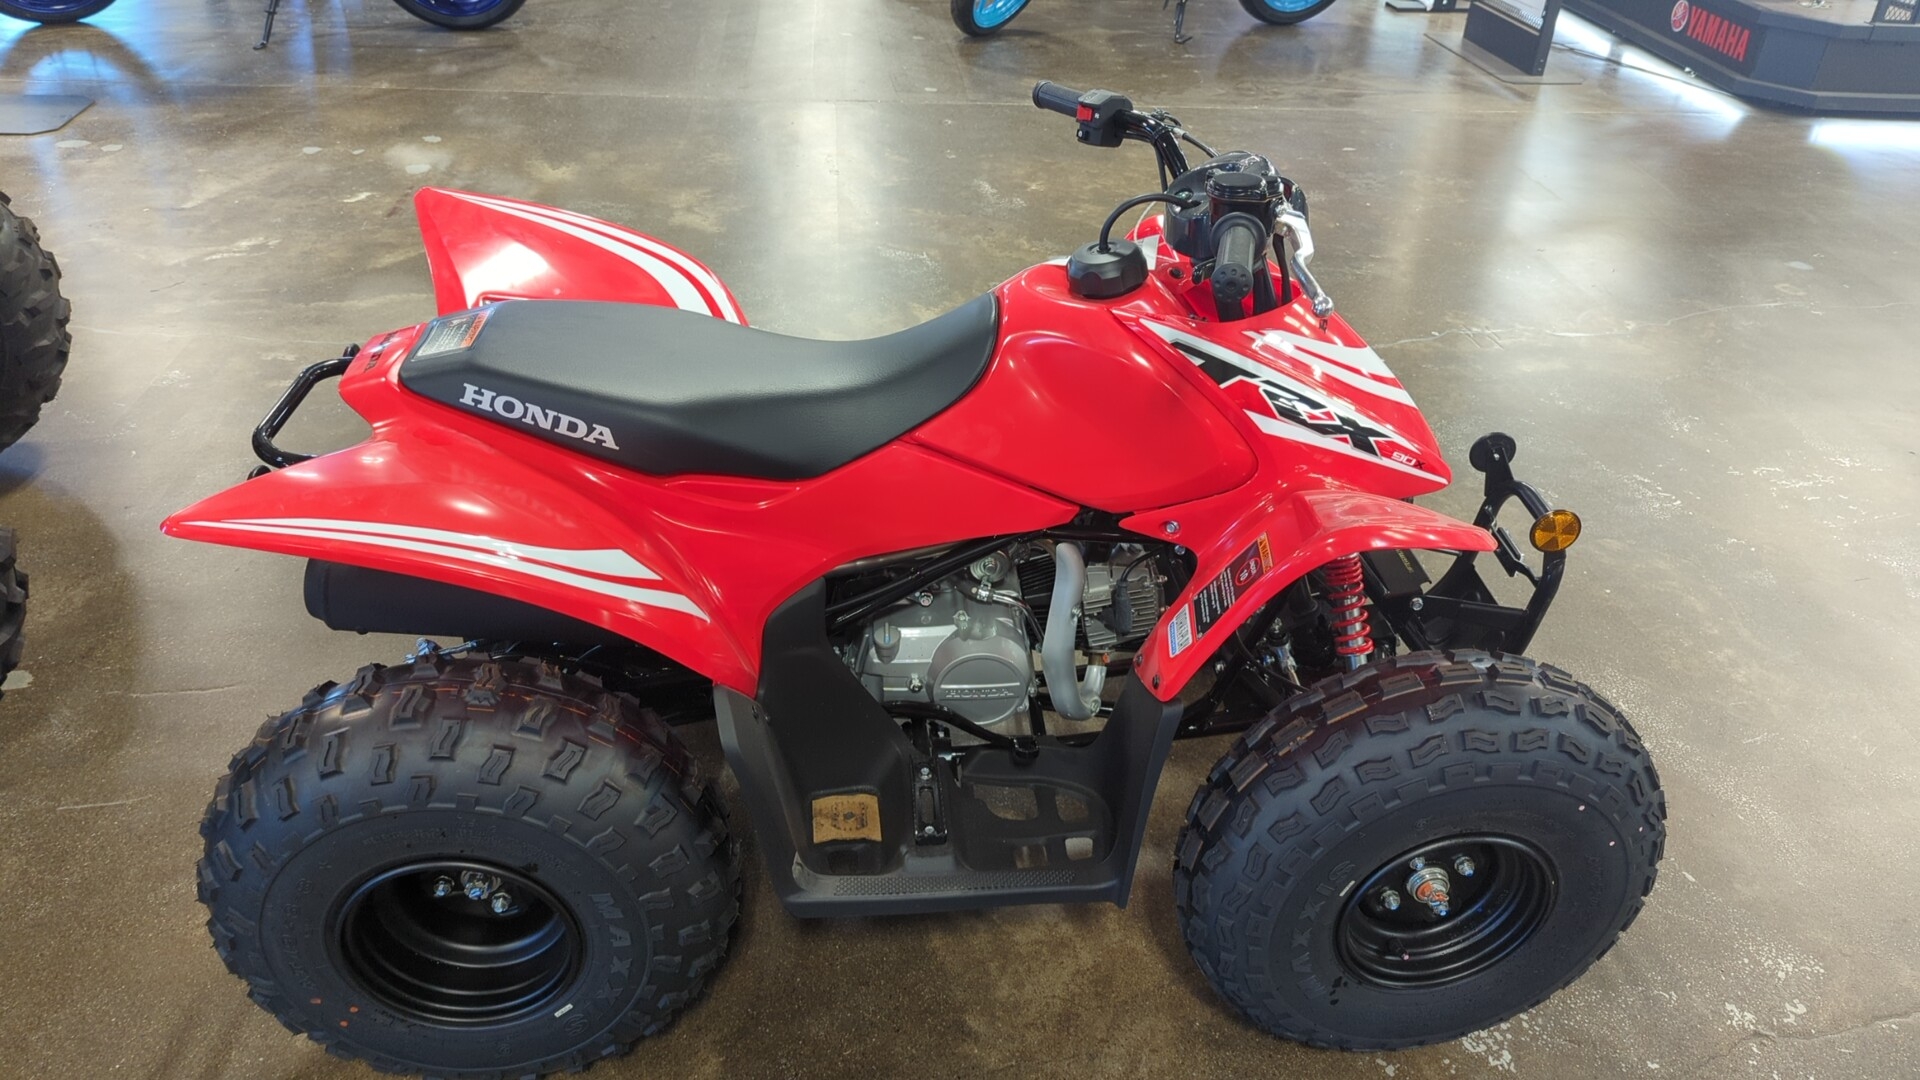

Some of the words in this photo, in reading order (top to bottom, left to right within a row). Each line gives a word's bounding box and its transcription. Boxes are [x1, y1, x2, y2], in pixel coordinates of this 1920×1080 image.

[1687, 6, 1750, 61] YAMAHA
[459, 383, 619, 450] HONDA
[946, 689, 1014, 698] HONDA
